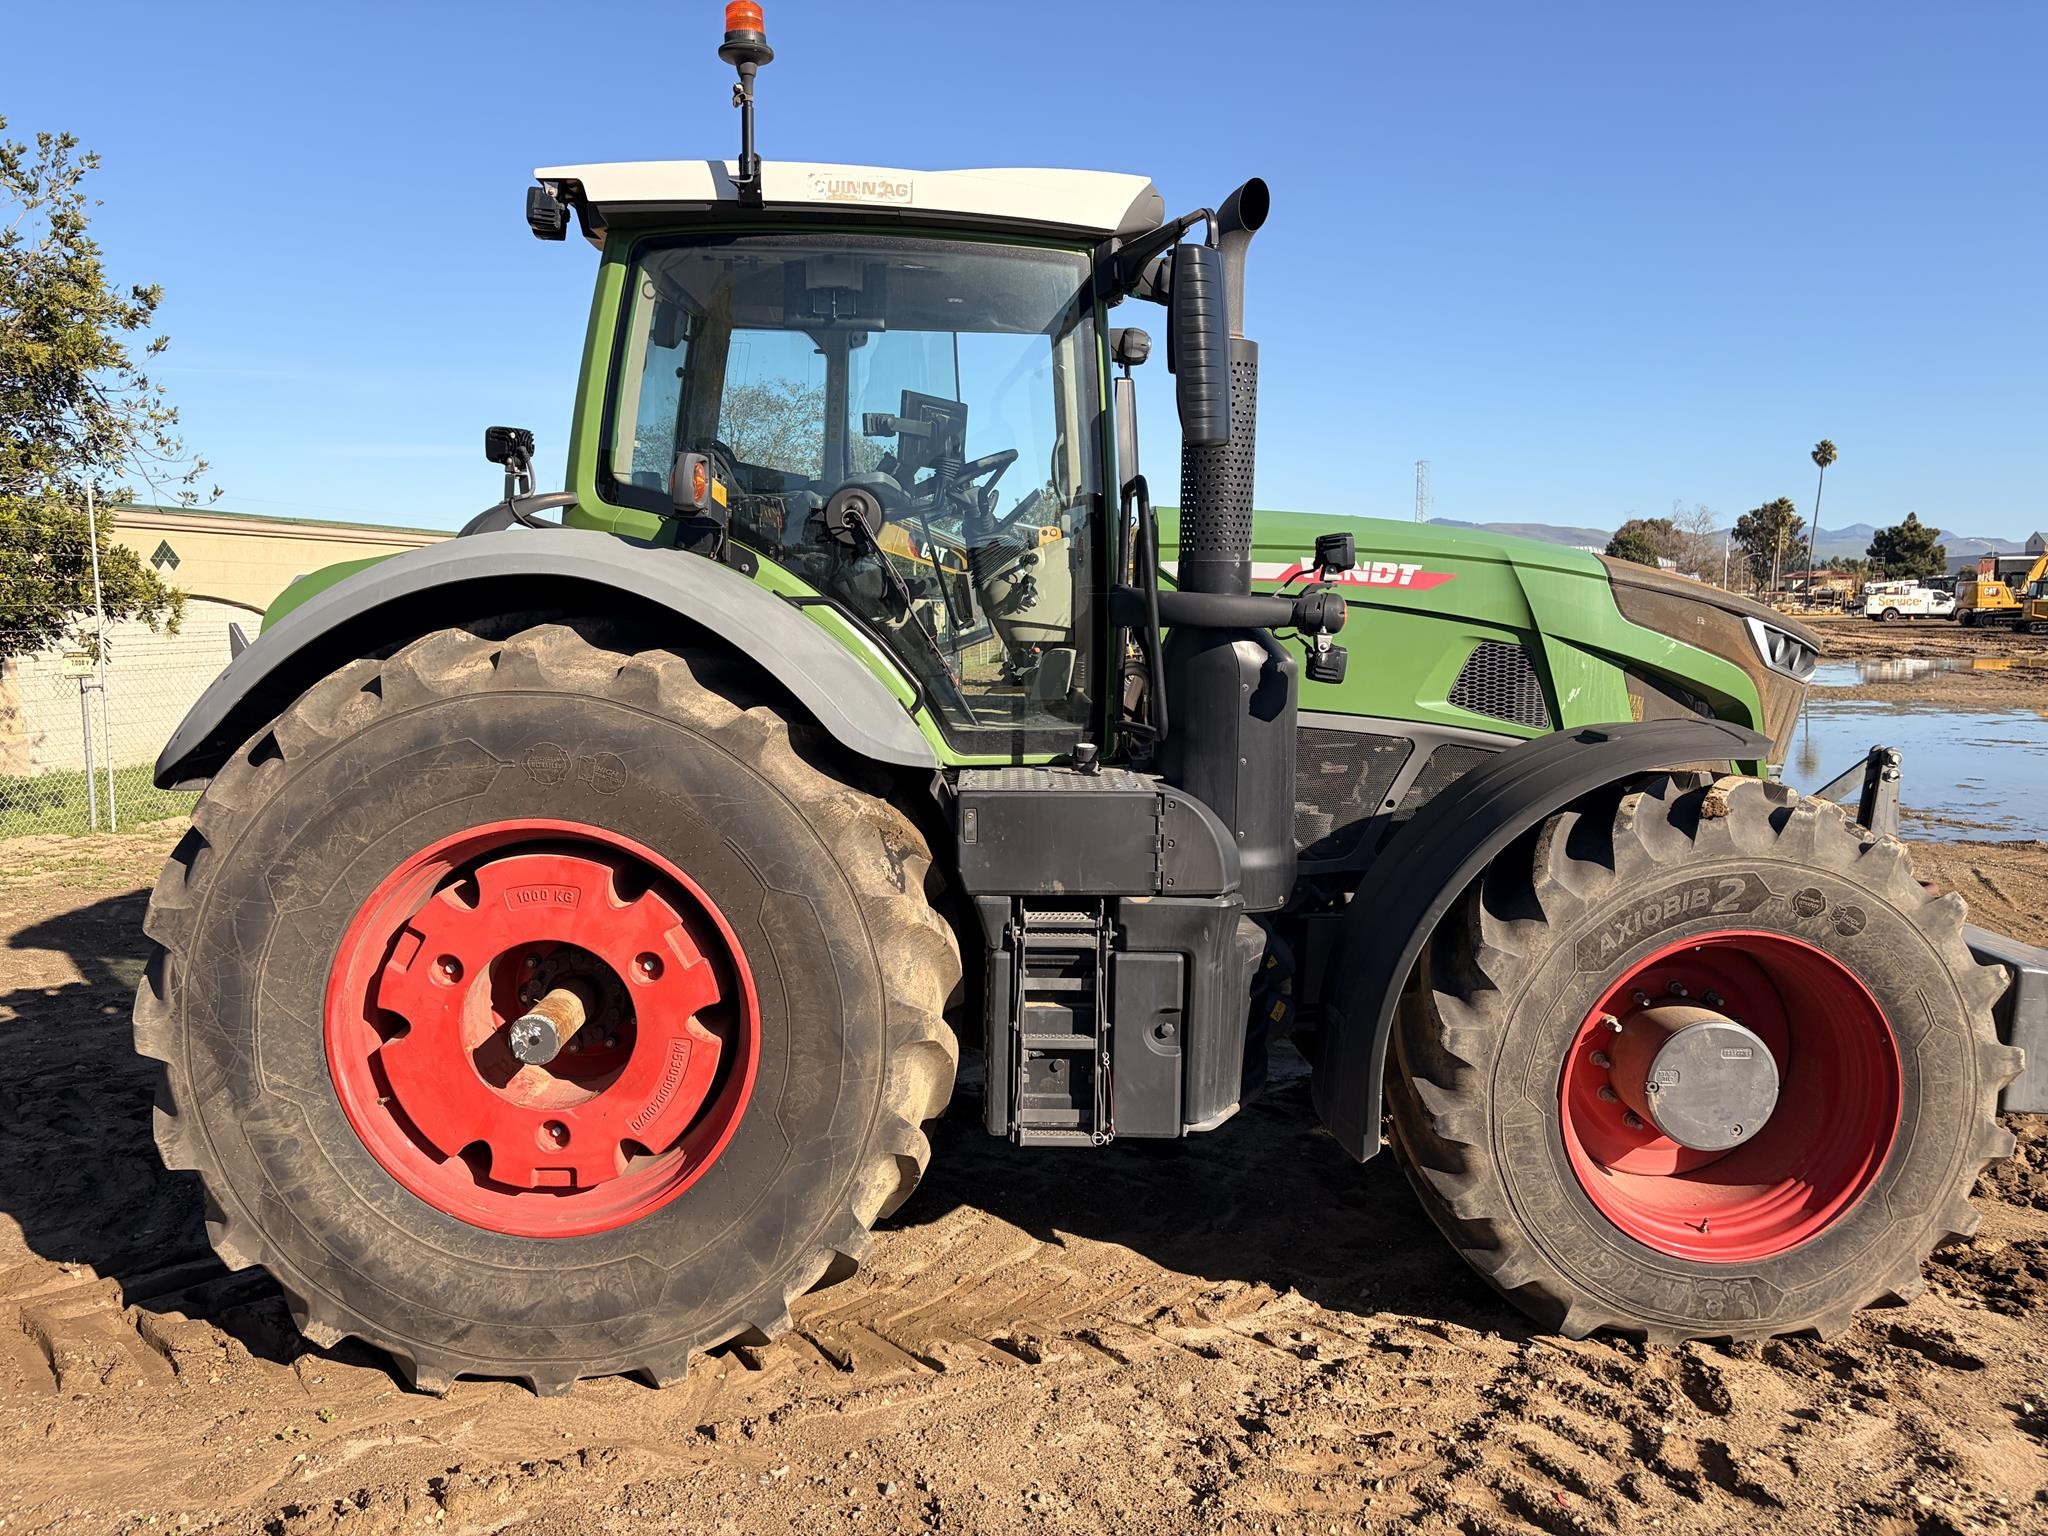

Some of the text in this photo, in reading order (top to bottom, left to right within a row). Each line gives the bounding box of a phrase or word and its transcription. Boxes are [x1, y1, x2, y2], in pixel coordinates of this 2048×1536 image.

[1300, 556, 1423, 586] FNDT
[1984, 587, 1997, 596] CAT
[1878, 596, 1920, 607] Service
[517, 888, 574, 904] 1000 KG
[1600, 877, 1746, 959] AXIOBIB 2
